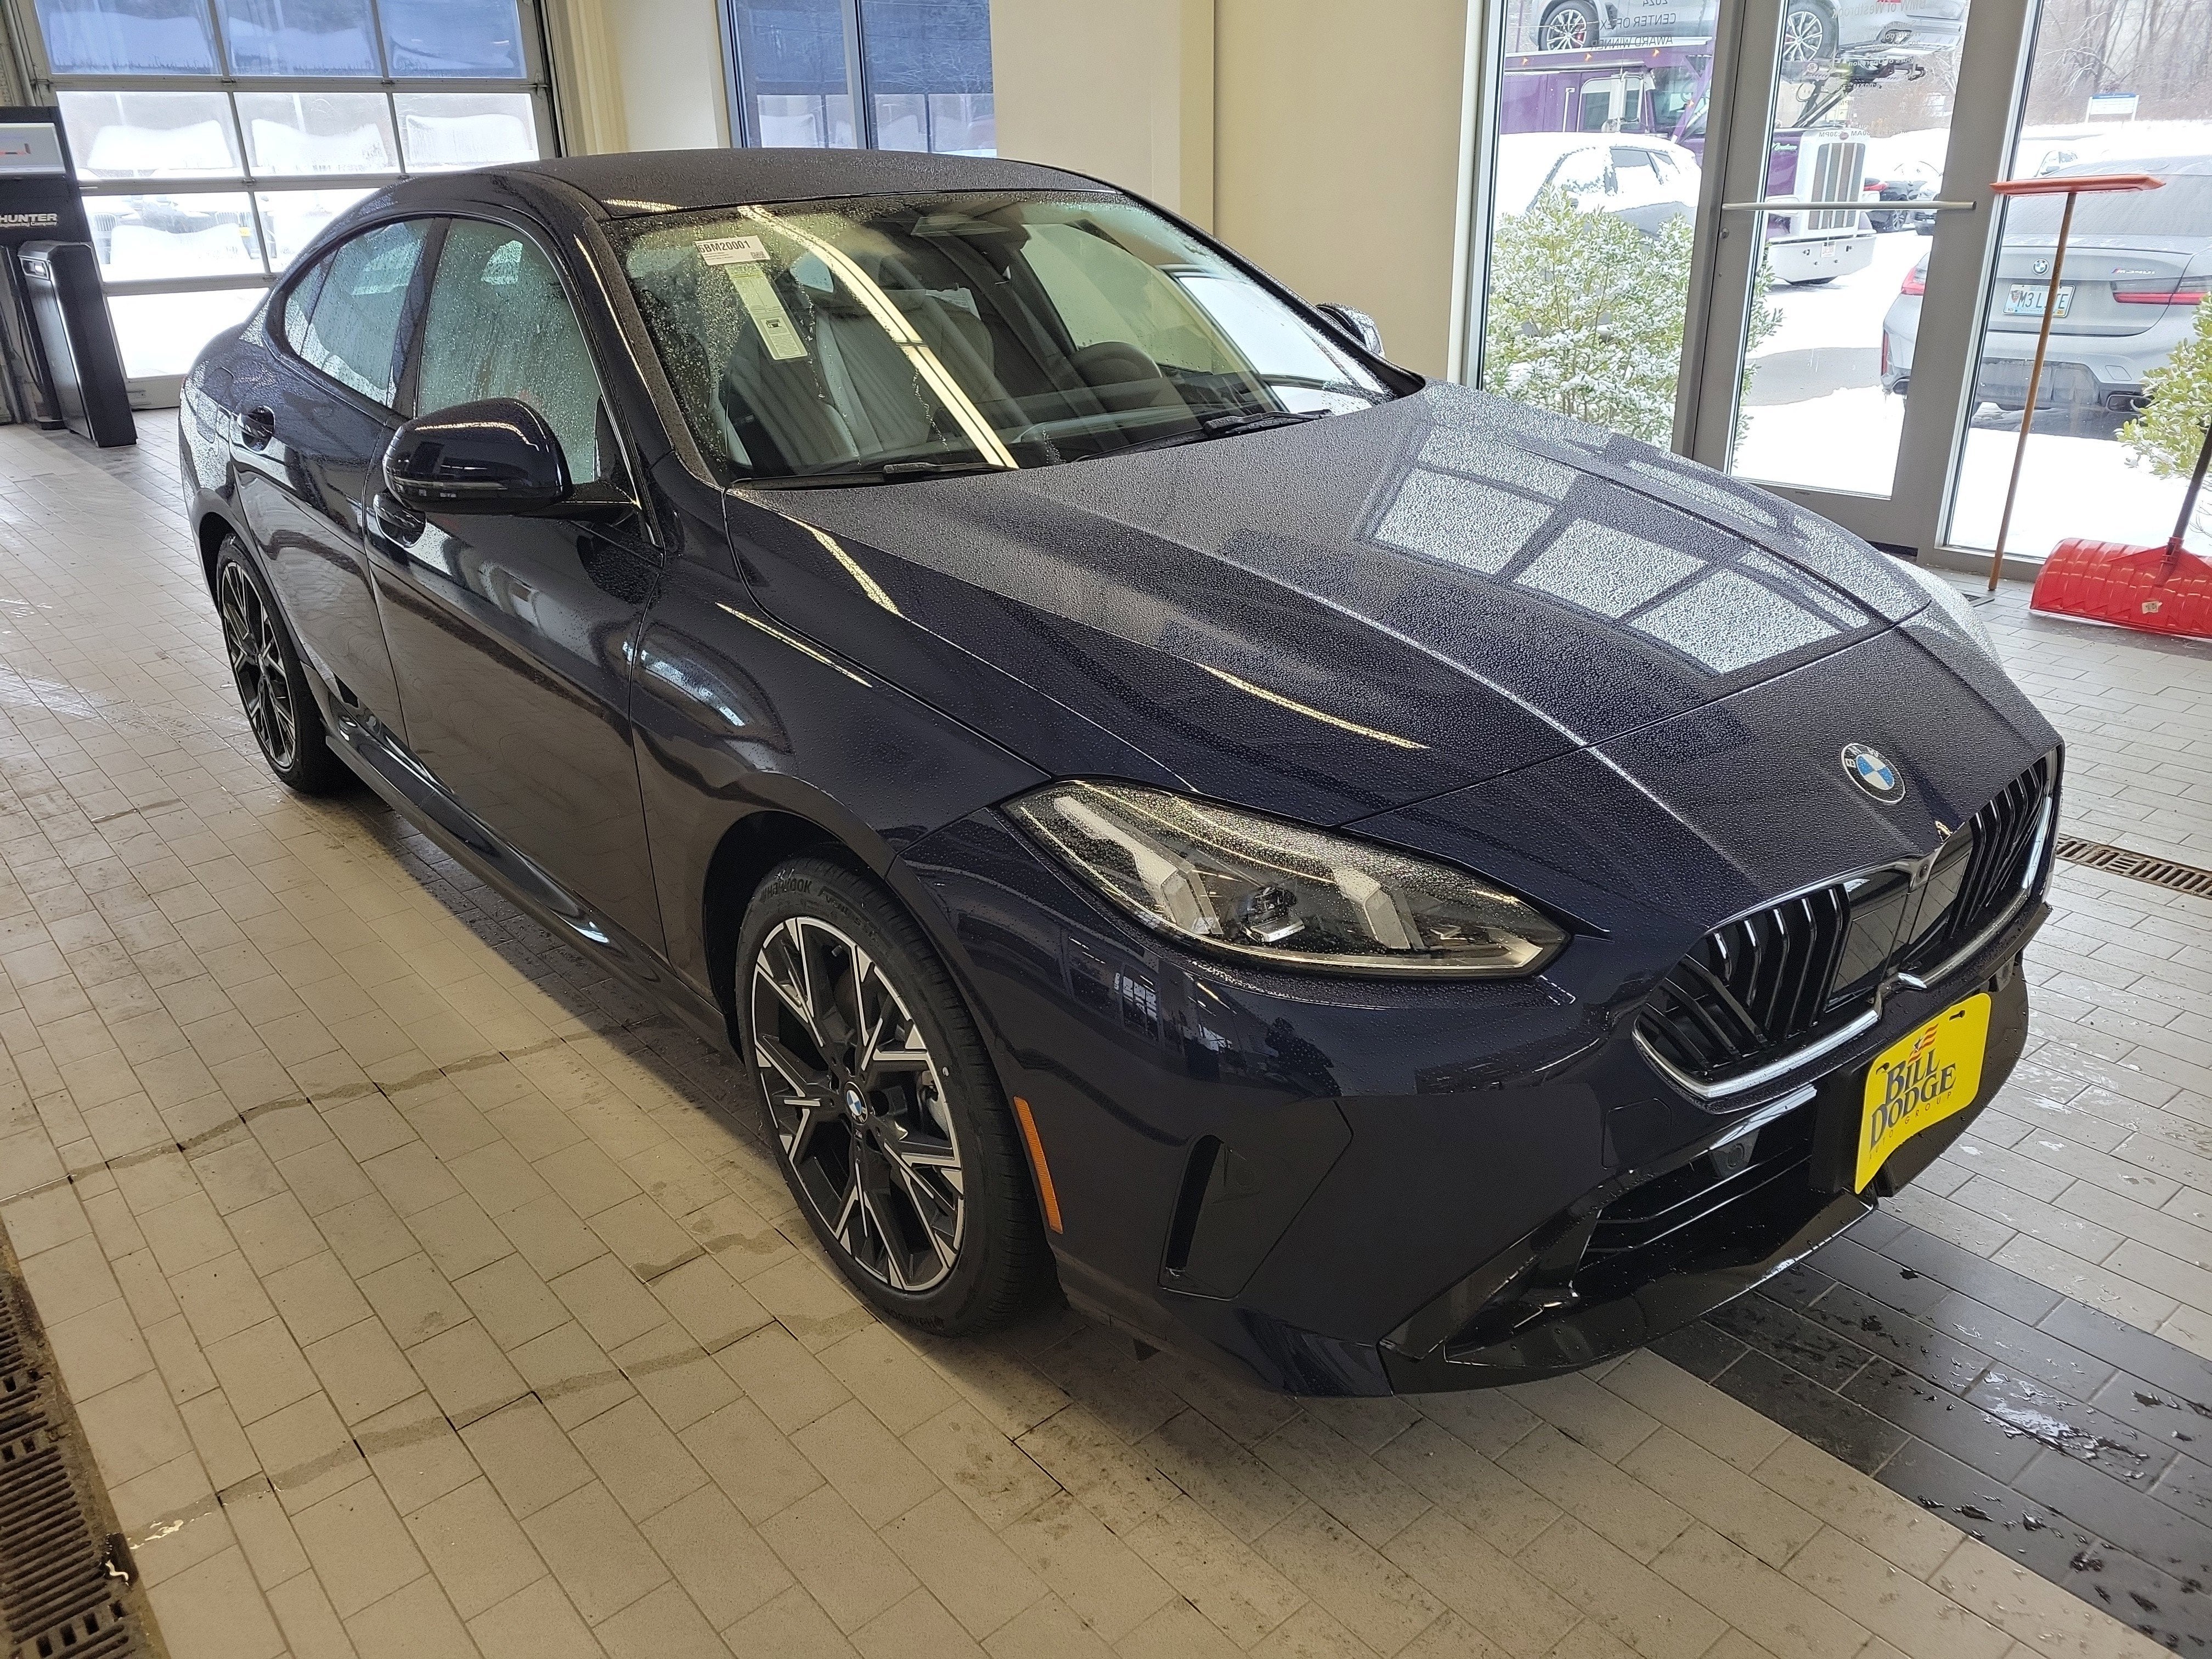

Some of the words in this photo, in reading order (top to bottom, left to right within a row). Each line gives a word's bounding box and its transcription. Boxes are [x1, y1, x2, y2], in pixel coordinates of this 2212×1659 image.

[0, 213, 58, 223] HUNTER
[2017, 291, 2034, 308] M3
[1845, 746, 1879, 769] BMW
[1885, 1047, 1940, 1106] BILL
[1870, 1062, 1956, 1153] DODGE
[1905, 1091, 1952, 1125] GROUP
